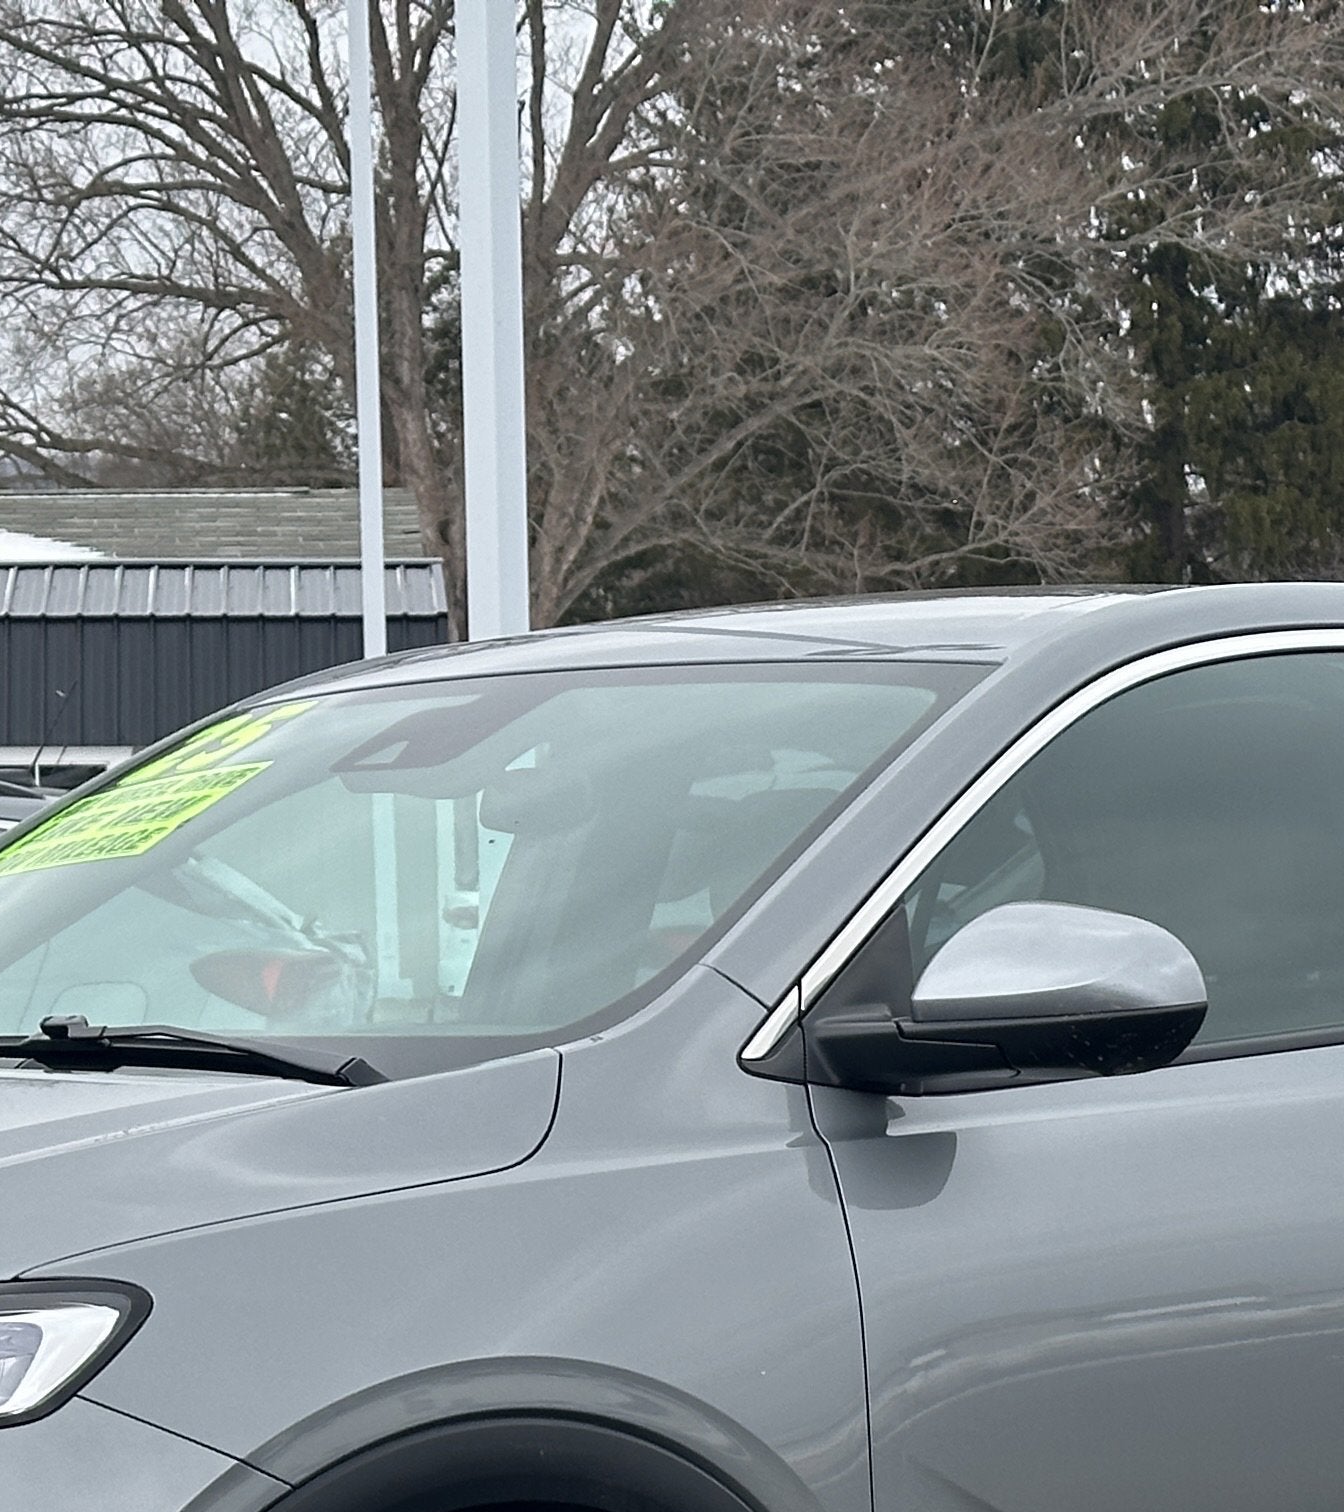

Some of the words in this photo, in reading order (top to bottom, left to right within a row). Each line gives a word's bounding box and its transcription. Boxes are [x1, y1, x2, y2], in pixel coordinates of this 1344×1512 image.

[112, 699, 320, 785] 25
[97, 793, 215, 829] NEW
[25, 825, 173, 865] MILEAGE
